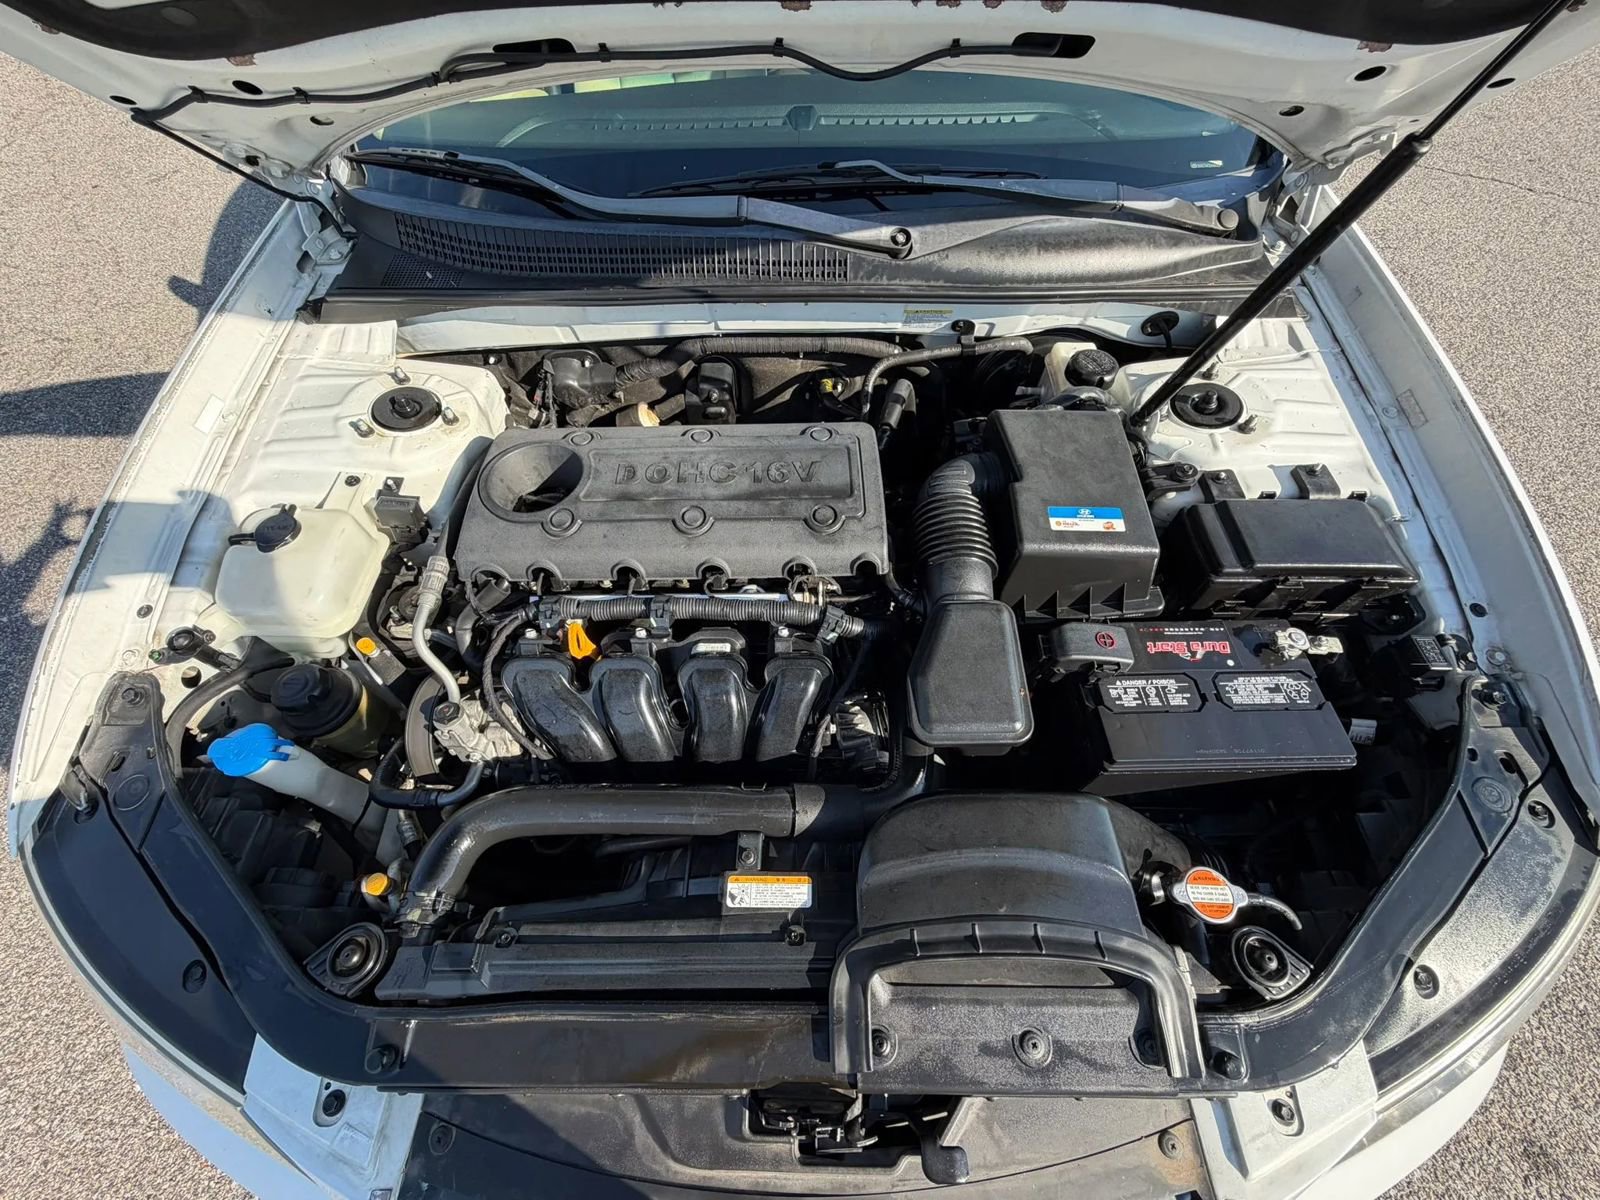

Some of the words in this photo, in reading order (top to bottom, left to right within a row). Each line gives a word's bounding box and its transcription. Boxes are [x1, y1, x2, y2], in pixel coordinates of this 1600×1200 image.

[615, 461, 738, 485] DOHC
[745, 460, 824, 484] 16V
[1147, 641, 1188, 655] Start
[1190, 641, 1231, 654] Dura
